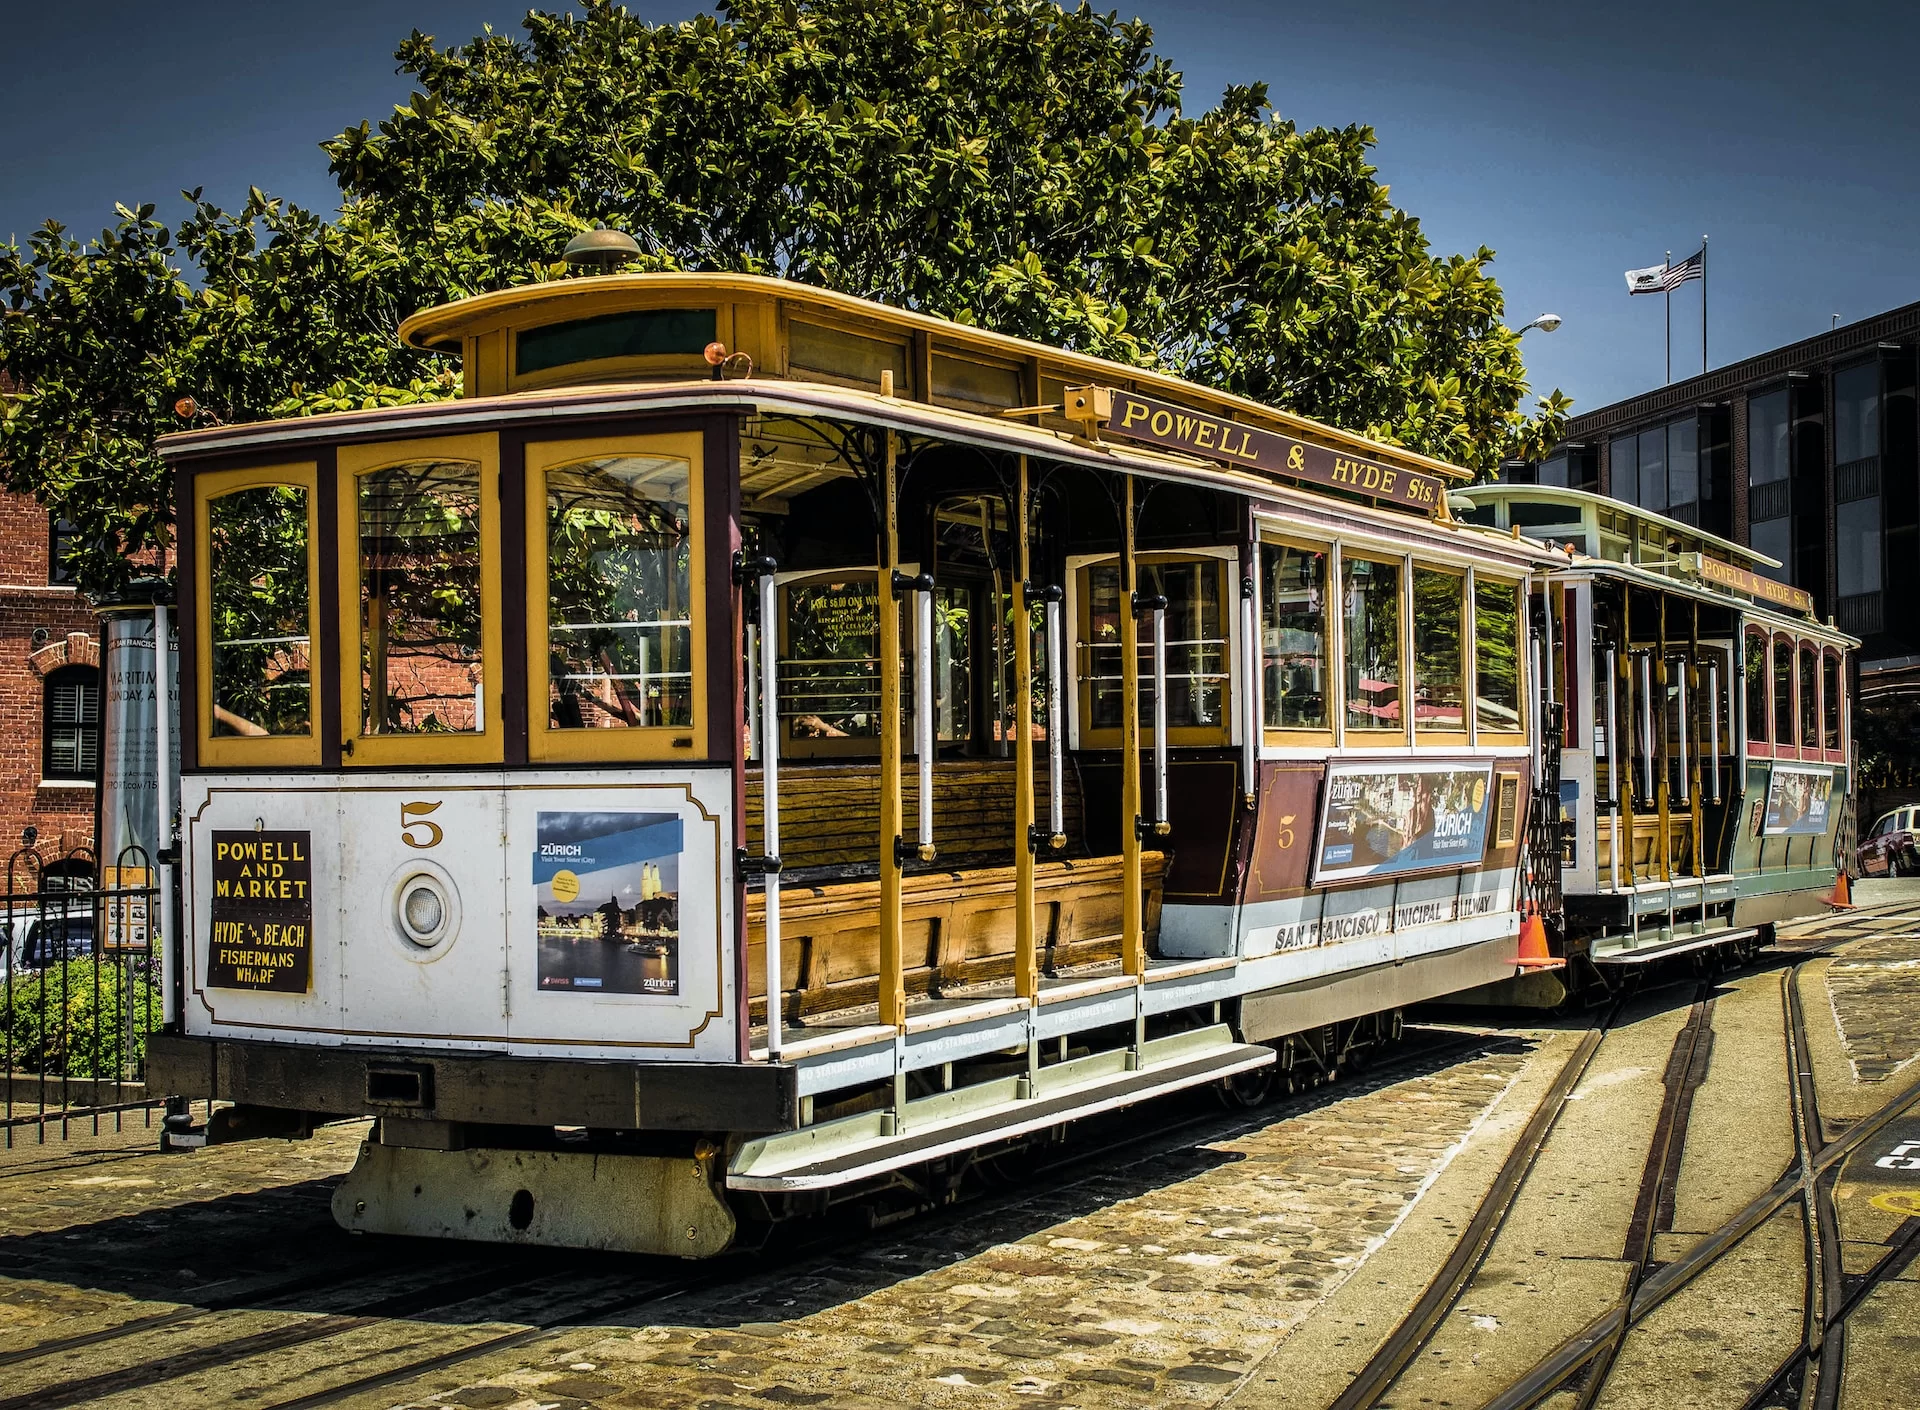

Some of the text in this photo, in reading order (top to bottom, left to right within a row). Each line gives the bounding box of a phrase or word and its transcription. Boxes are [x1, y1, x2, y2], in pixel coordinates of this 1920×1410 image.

[1120, 400, 1434, 502] POWELL & HYDE Sts.
[1704, 560, 1747, 588] POWELL
[1753, 577, 1760, 593] &
[1765, 581, 1791, 602] HYDE
[847, 595, 863, 607] ONE
[127, 639, 156, 649] FRANCISC
[110, 671, 157, 685] MARITIM
[147, 688, 180, 701] ARI
[401, 800, 443, 849] 5
[1278, 813, 1297, 849] 5
[217, 842, 305, 861] POWELL
[541, 843, 582, 856] ZÜRICH
[240, 863, 284, 878] AND
[216, 880, 307, 898] MARKET
[214, 921, 305, 947] HYDE AND BEACH
[1275, 924, 1305, 950] SAN
[220, 949, 294, 968] FISHERMANS
[236, 967, 275, 984] WHARF
[925, 1040, 943, 1053] TWO
